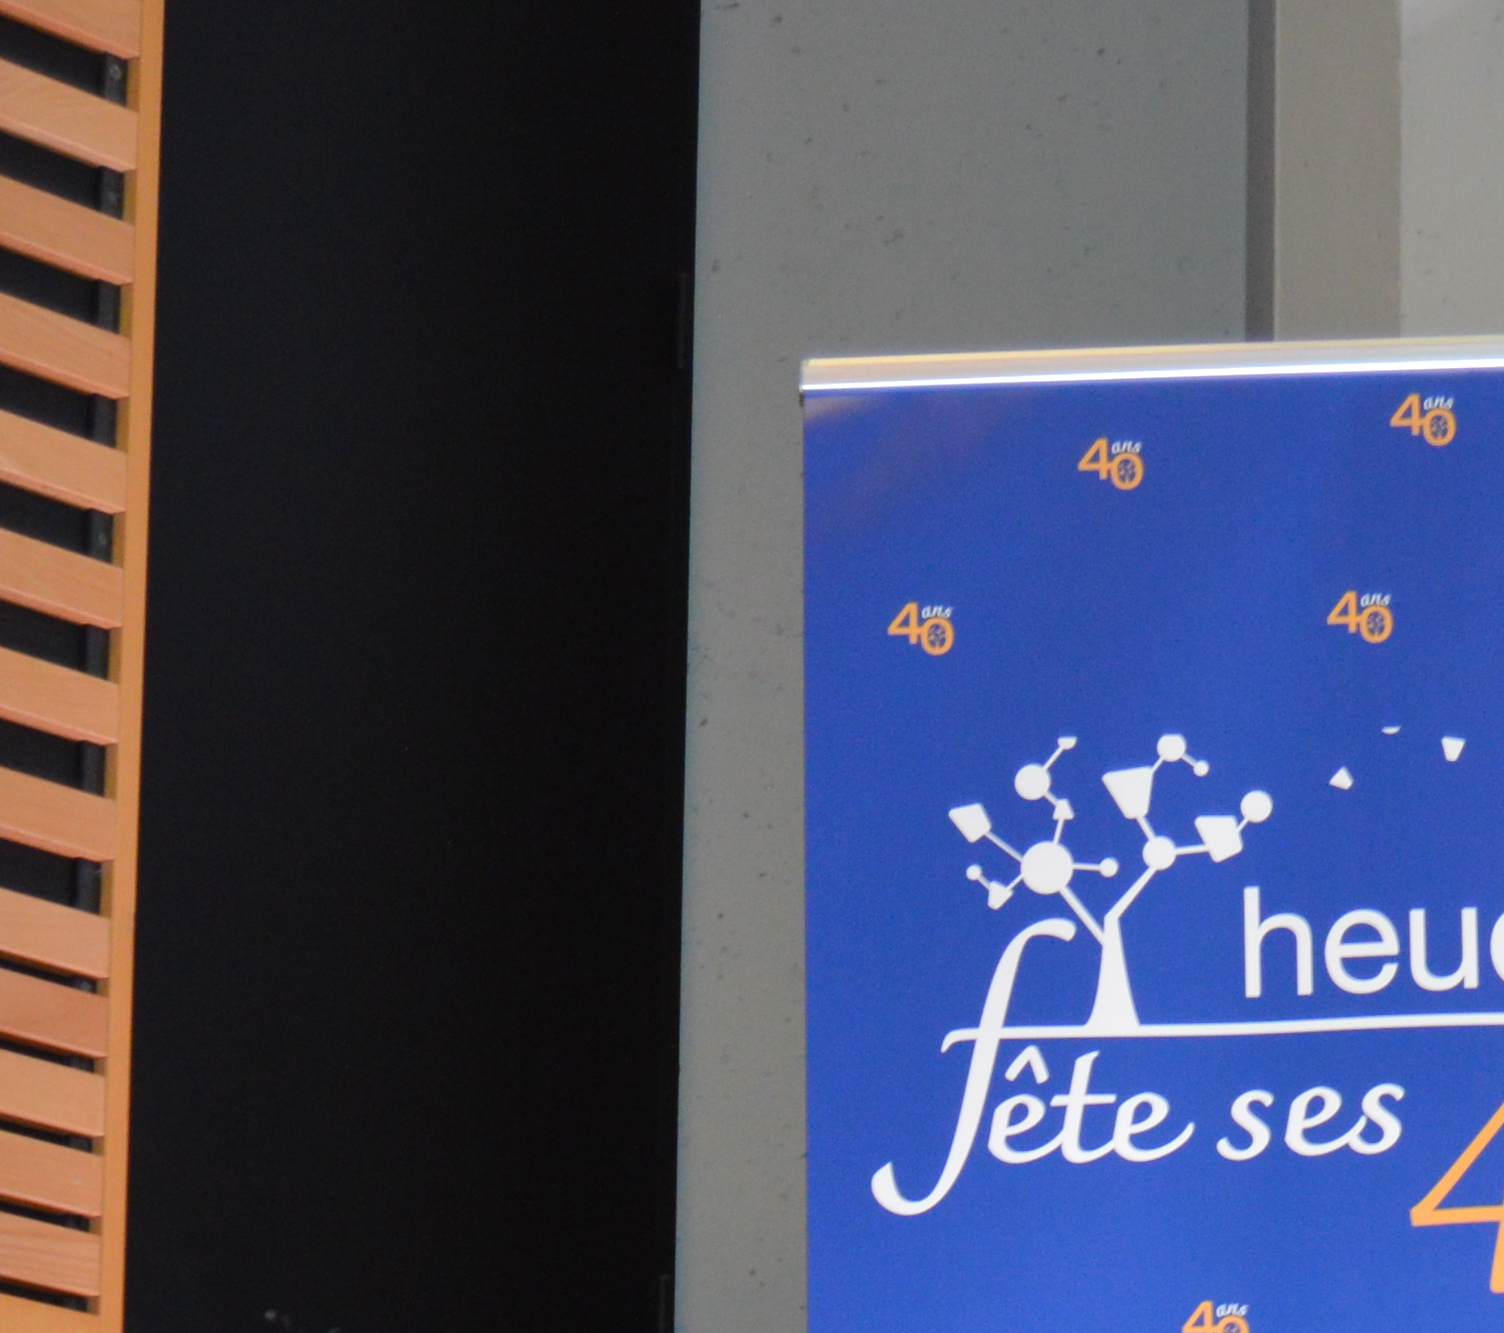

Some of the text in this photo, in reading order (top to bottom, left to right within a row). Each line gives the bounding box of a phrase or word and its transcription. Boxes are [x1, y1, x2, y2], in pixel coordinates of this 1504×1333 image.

[1391, 394, 1456, 446] 40
[1078, 439, 1143, 490] 40
[888, 603, 954, 656] 40
[1327, 592, 1393, 643] 40
[871, 918, 1194, 1215] fête
[1217, 1083, 1406, 1160] ses
